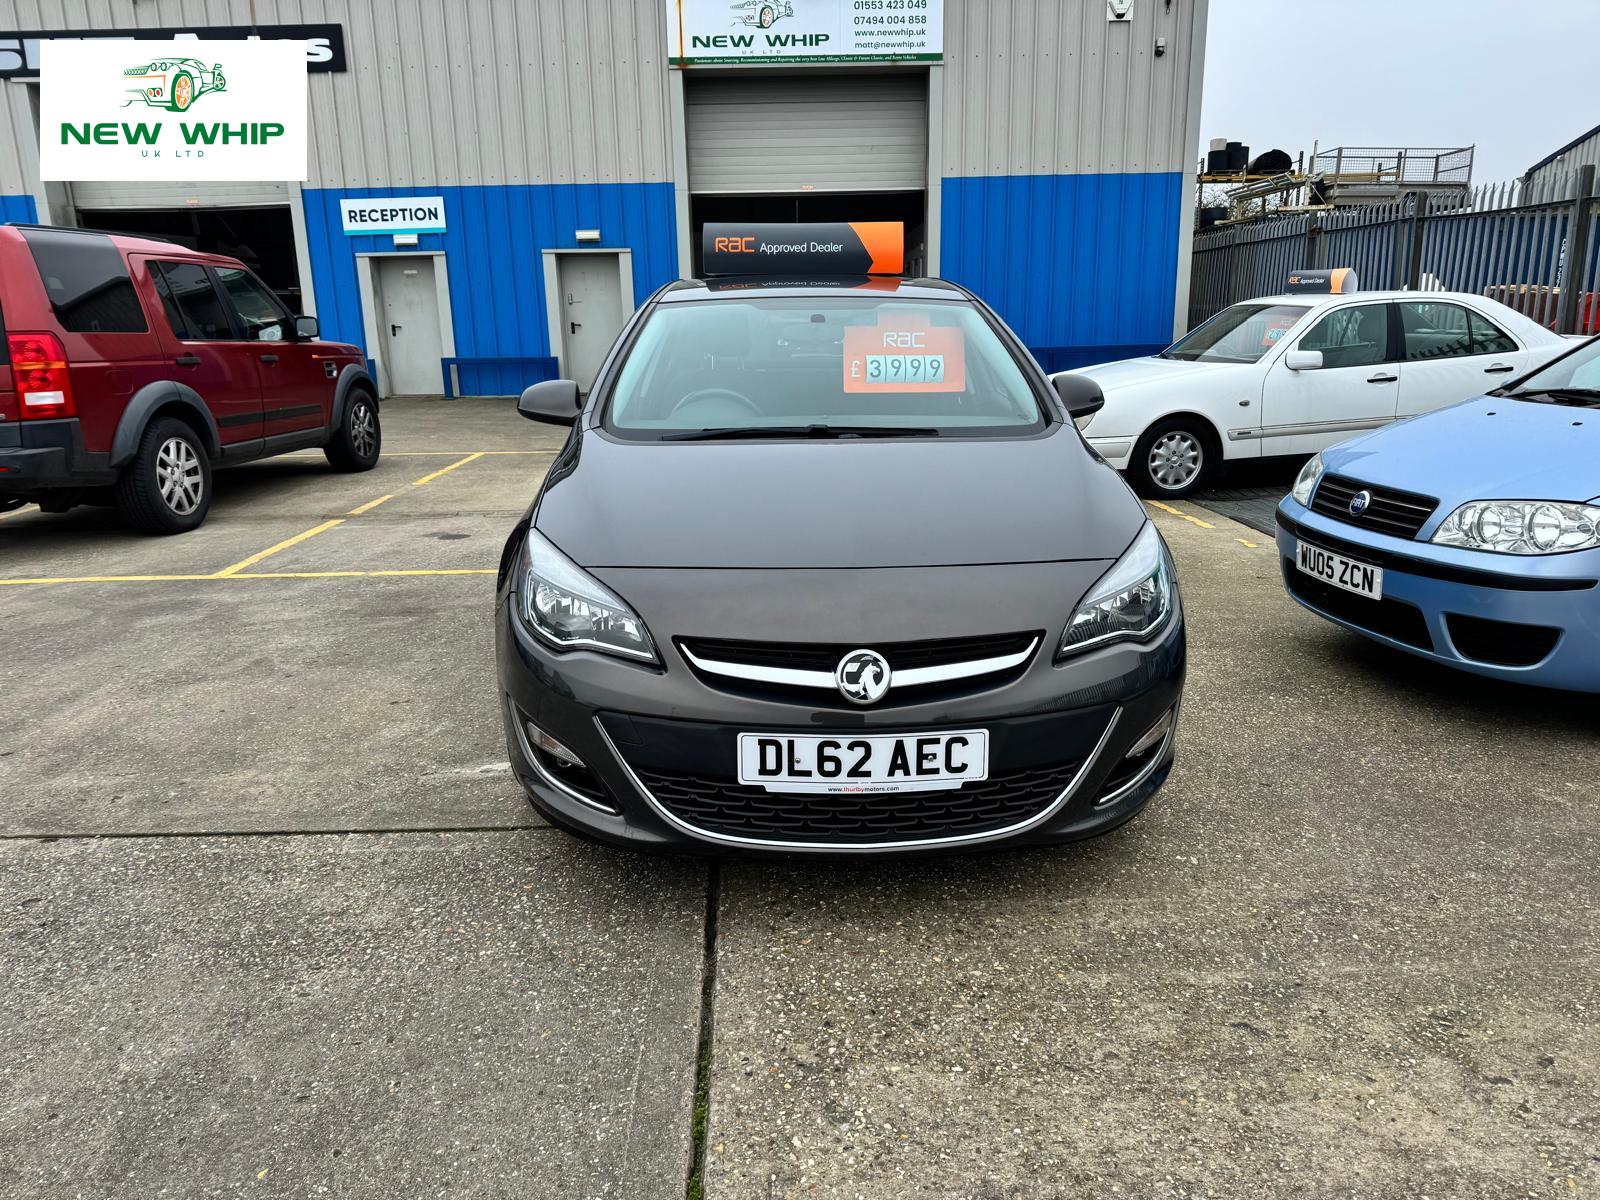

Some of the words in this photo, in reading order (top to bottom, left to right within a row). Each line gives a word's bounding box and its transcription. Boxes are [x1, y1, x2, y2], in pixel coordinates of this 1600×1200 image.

[853, 0, 883, 10] 01553
[886, 0, 905, 10] 423
[907, 0, 927, 9] 049
[853, 16, 884, 25] 07494
[886, 15, 906, 25] 004
[908, 15, 927, 24] 858
[854, 28, 926, 37] www.newwhip.uk
[692, 35, 754, 48] NEW
[765, 33, 830, 47] WHIP
[854, 41, 926, 50] matt@newwhip.uk
[348, 207, 439, 223] RECEPTION
[759, 242, 807, 255] Approved
[810, 242, 843, 253] Dealer
[1351, 498, 1365, 508] FIAT
[1301, 544, 1334, 580] WU05
[1339, 559, 1375, 593] ZCN
[758, 738, 873, 778] DL62
[887, 736, 969, 778] AEC
[827, 785, 900, 794] www.thurlbymotors.com
